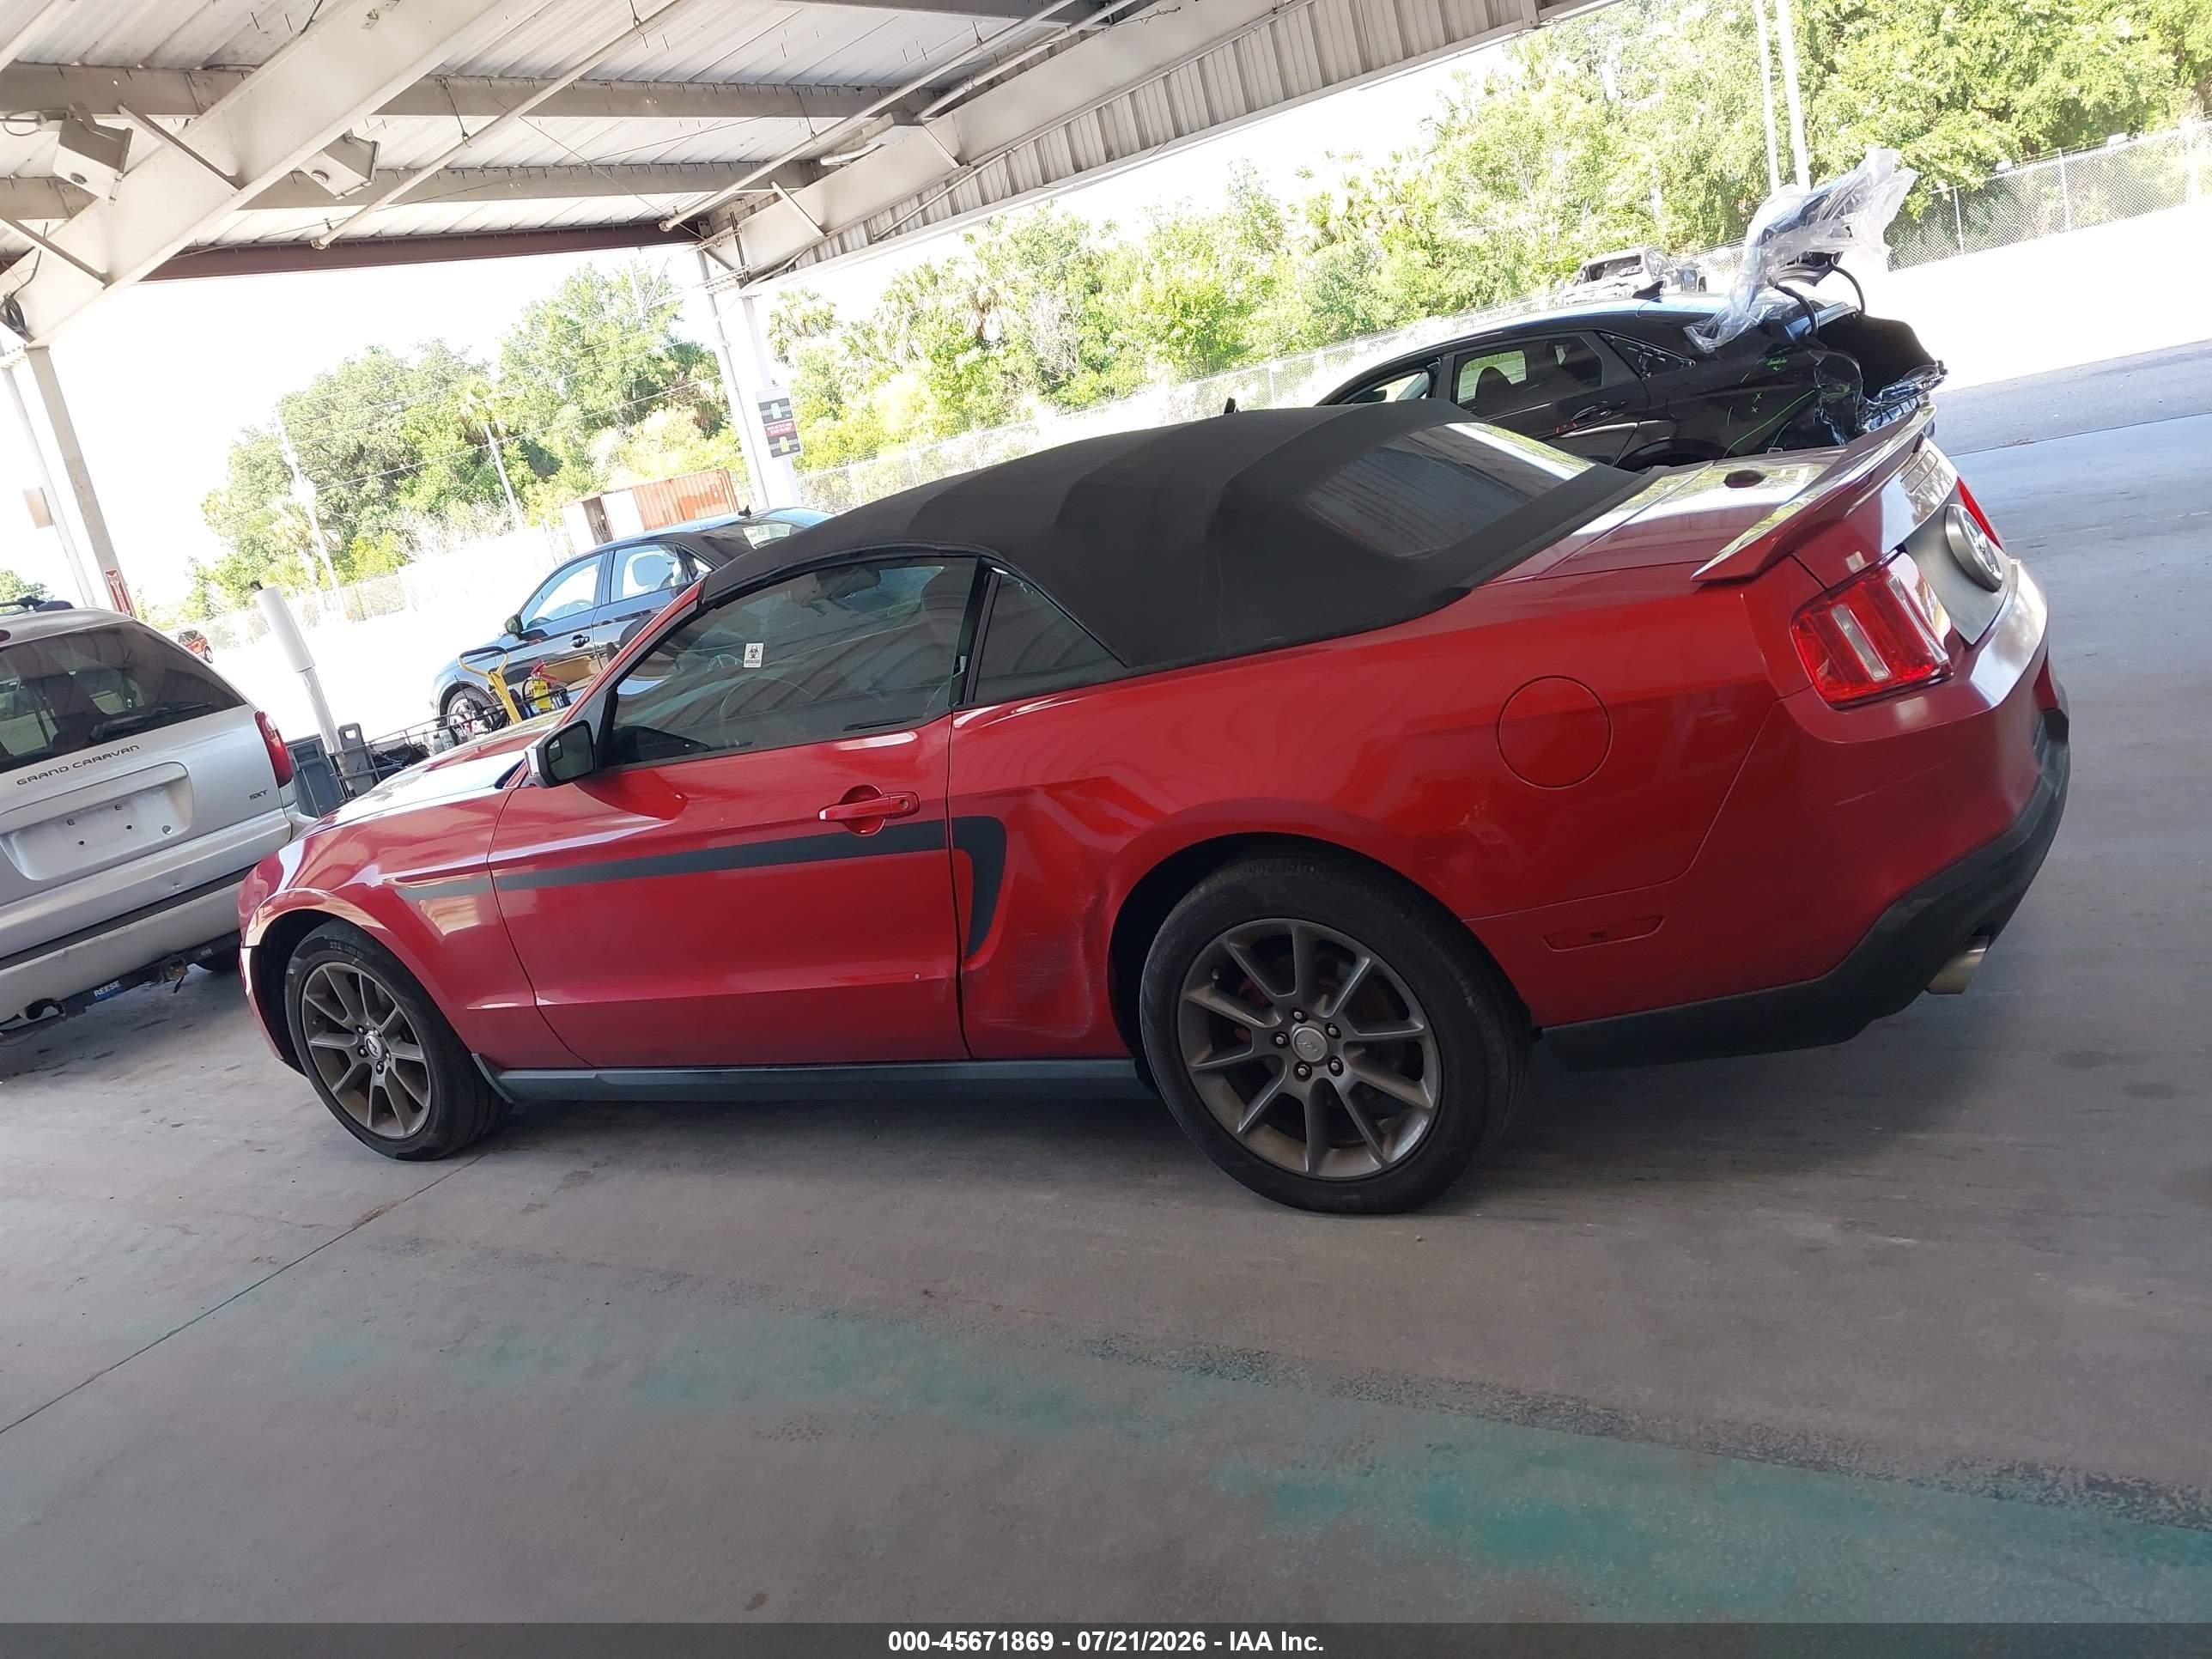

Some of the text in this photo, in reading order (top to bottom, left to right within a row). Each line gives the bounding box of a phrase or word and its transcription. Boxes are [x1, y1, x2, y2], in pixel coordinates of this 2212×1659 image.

[16, 744, 140, 786] GRAND CARAVAN
[249, 789, 268, 800] SXT
[94, 981, 120, 997] REESE
